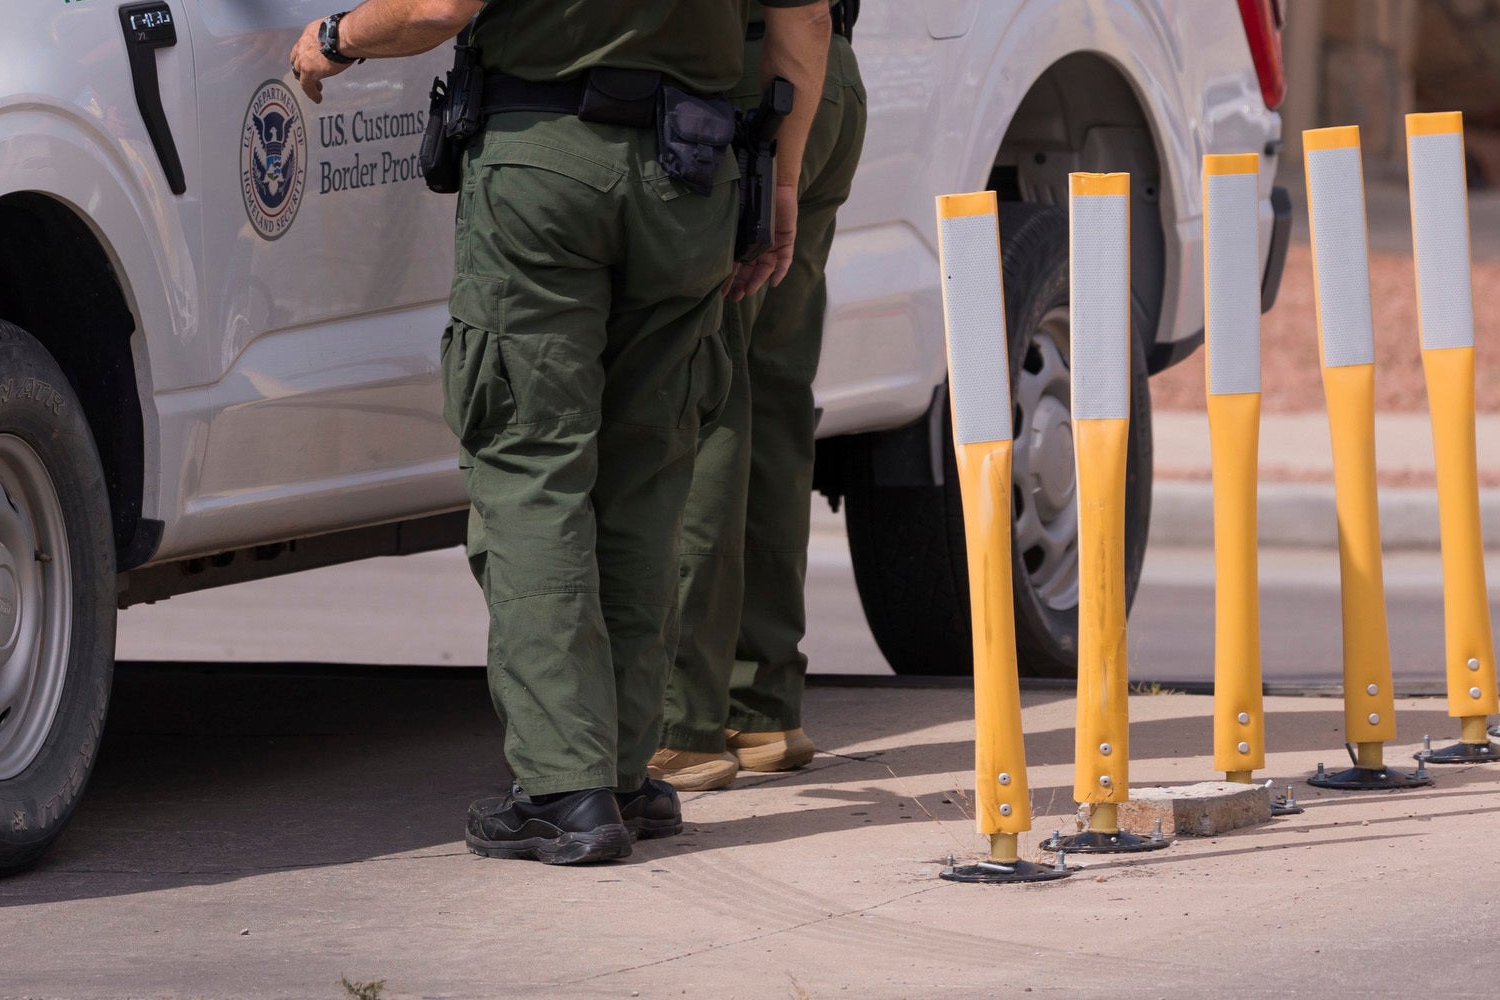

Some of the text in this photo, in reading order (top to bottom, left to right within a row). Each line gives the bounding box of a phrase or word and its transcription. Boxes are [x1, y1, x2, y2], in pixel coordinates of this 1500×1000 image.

[253, 87, 299, 122] DEPARTMENT
[319, 110, 425, 148] U.S. Customs
[319, 151, 424, 195] Border Prote
[243, 168, 304, 232] HOMELAND SECURITY
[18, 377, 65, 415] ATR
